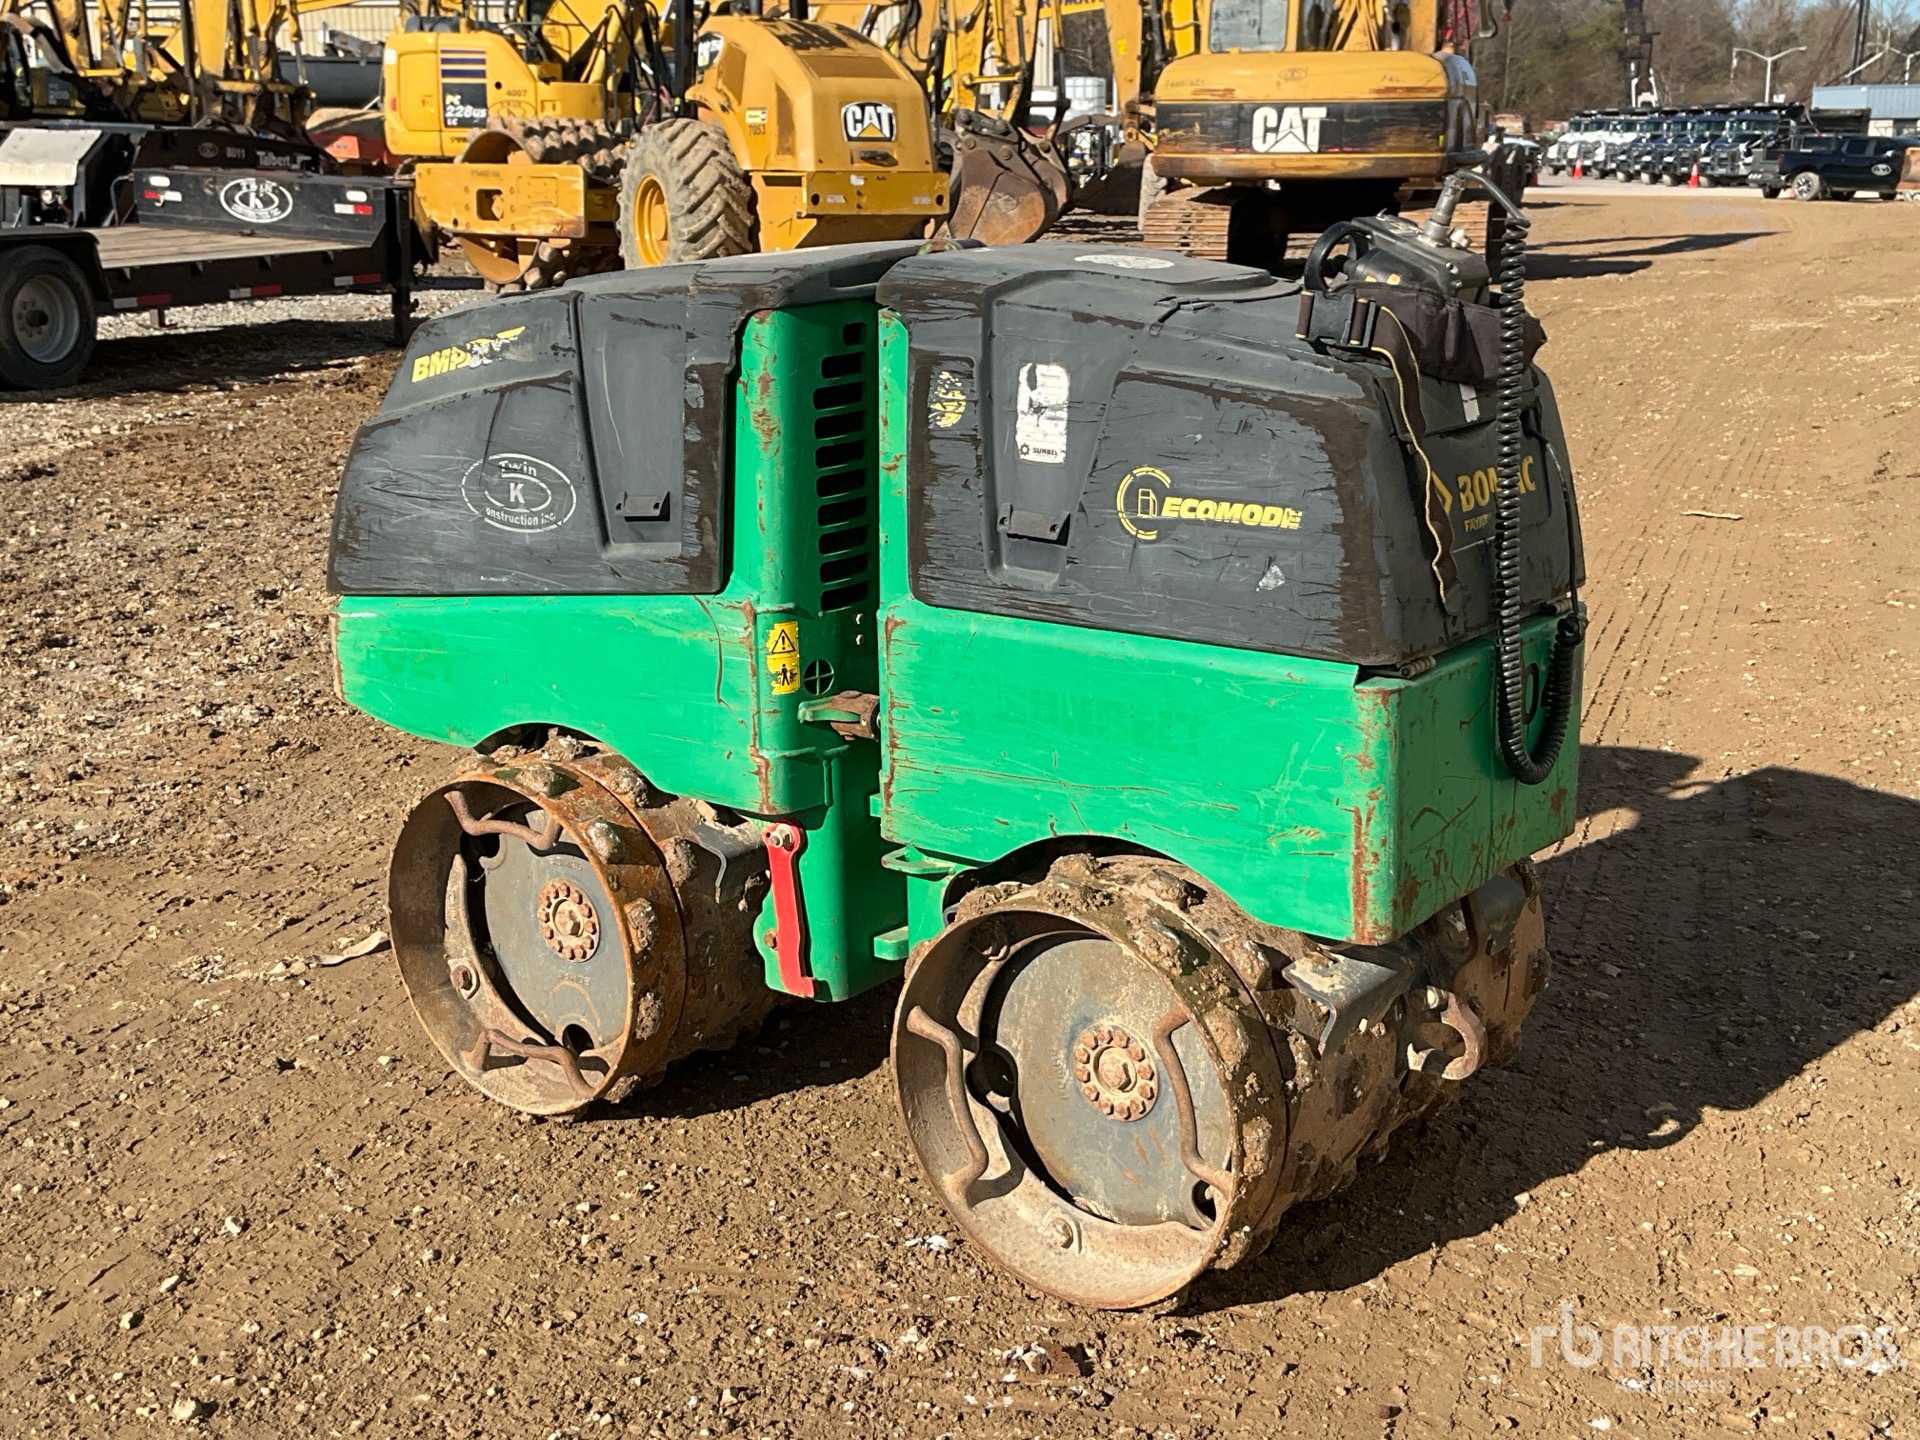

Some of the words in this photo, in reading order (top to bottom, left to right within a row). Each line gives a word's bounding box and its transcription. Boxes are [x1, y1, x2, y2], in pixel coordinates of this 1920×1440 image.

[445, 95, 461, 105] PC
[846, 104, 893, 138] CAT
[1252, 107, 1327, 153] CAT
[257, 151, 290, 167] Talbert
[499, 460, 537, 476] Twin
[509, 482, 525, 504] K
[1161, 496, 1302, 530] ECOMODE
